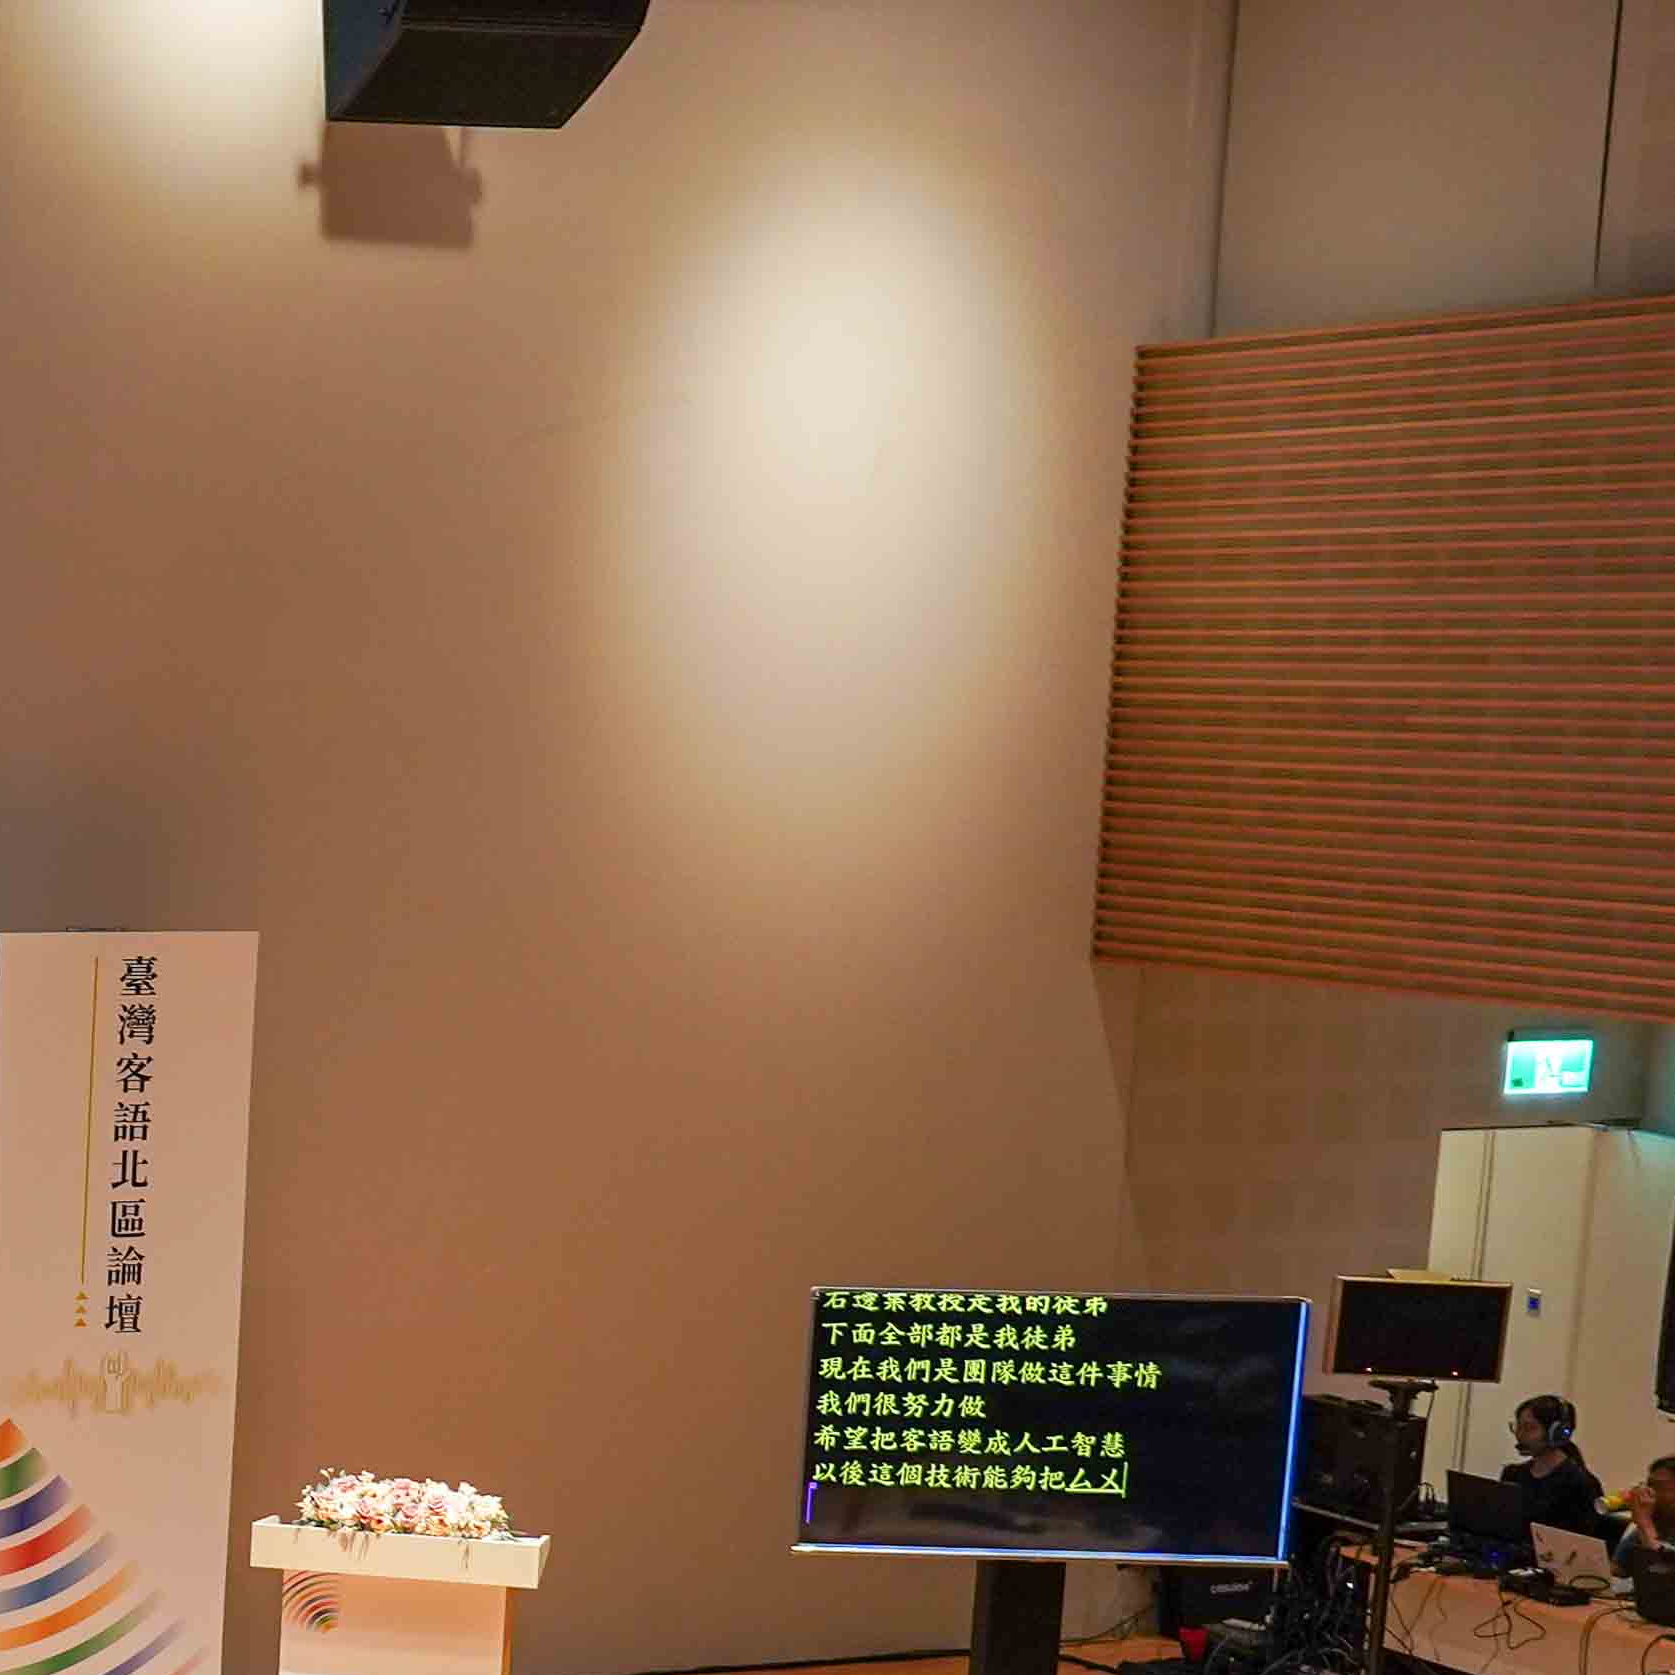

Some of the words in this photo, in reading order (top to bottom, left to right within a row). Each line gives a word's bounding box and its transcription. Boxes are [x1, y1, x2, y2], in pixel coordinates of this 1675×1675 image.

[105, 955, 159, 1334] 臺灣客語北區論壇
[821, 1321, 1077, 1351] 下面全部都是我徒弟
[818, 1355, 1163, 1389] 現在我們是團隊做這件事情
[815, 1391, 987, 1419] 我們很努力做
[813, 1424, 1126, 1459] 希望把客語變成人工智慧
